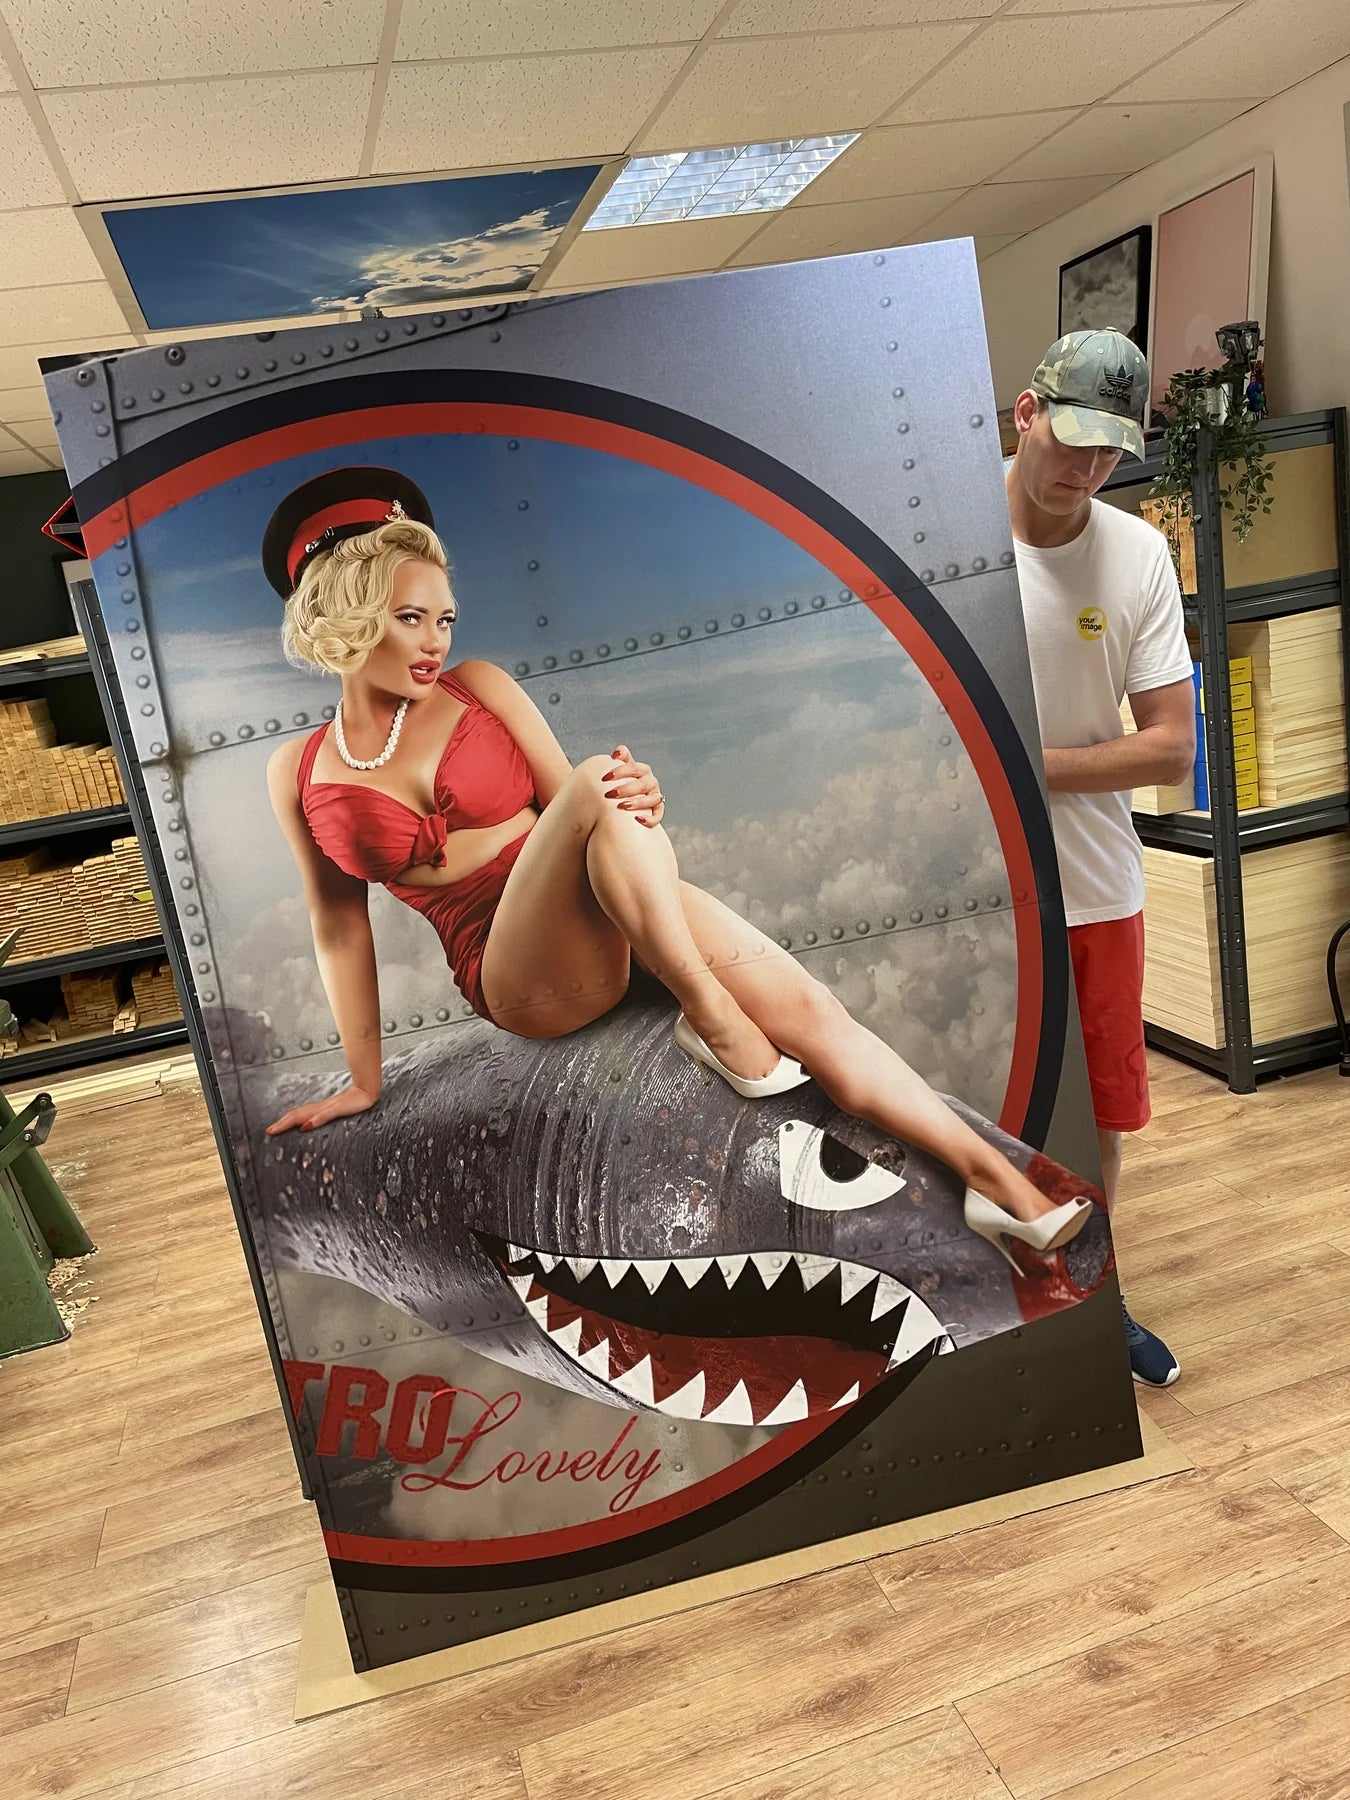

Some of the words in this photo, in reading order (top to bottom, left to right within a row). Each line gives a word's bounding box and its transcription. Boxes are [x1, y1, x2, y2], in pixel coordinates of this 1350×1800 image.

[1079, 617, 1095, 625] your
[1081, 624, 1102, 632] image
[400, 1386, 662, 1513] Lovely
